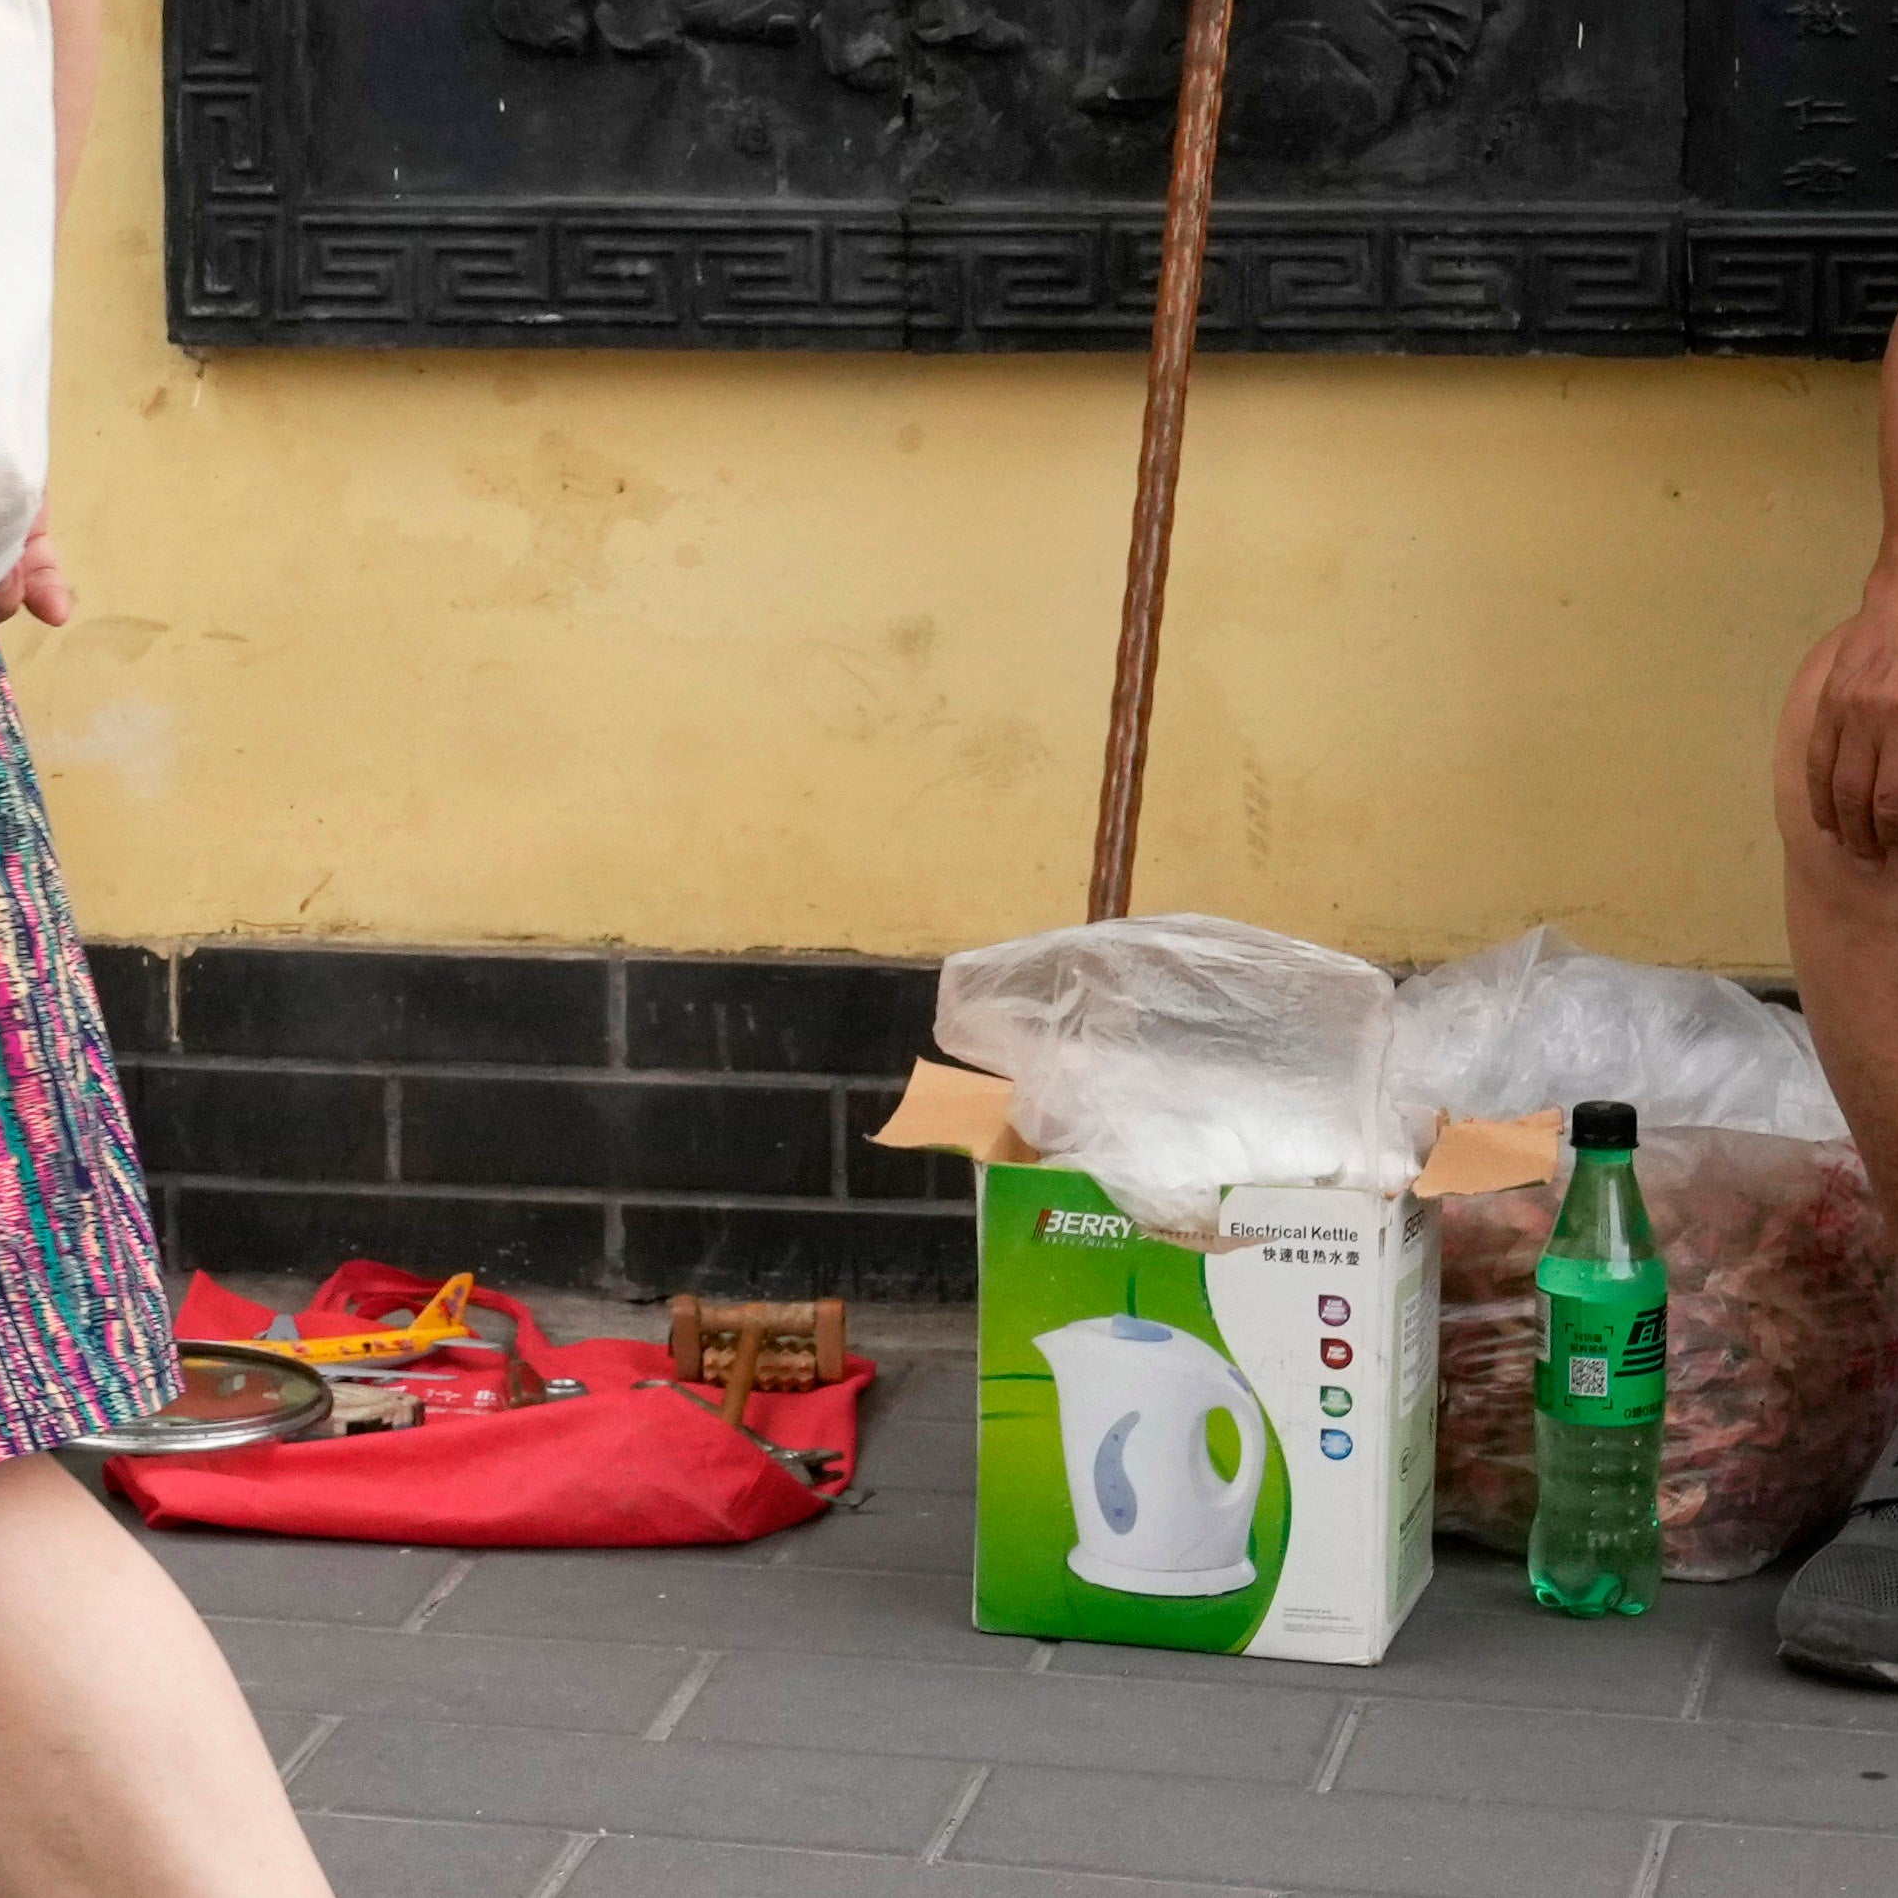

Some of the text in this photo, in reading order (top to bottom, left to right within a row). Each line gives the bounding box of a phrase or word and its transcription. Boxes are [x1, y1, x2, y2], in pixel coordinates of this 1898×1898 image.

[1034, 1208, 1136, 1240] BERRY
[1230, 1221, 1308, 1241] Electrical
[1311, 1224, 1359, 1243] Kettle
[1262, 1246, 1361, 1266] 快速电热水壶
